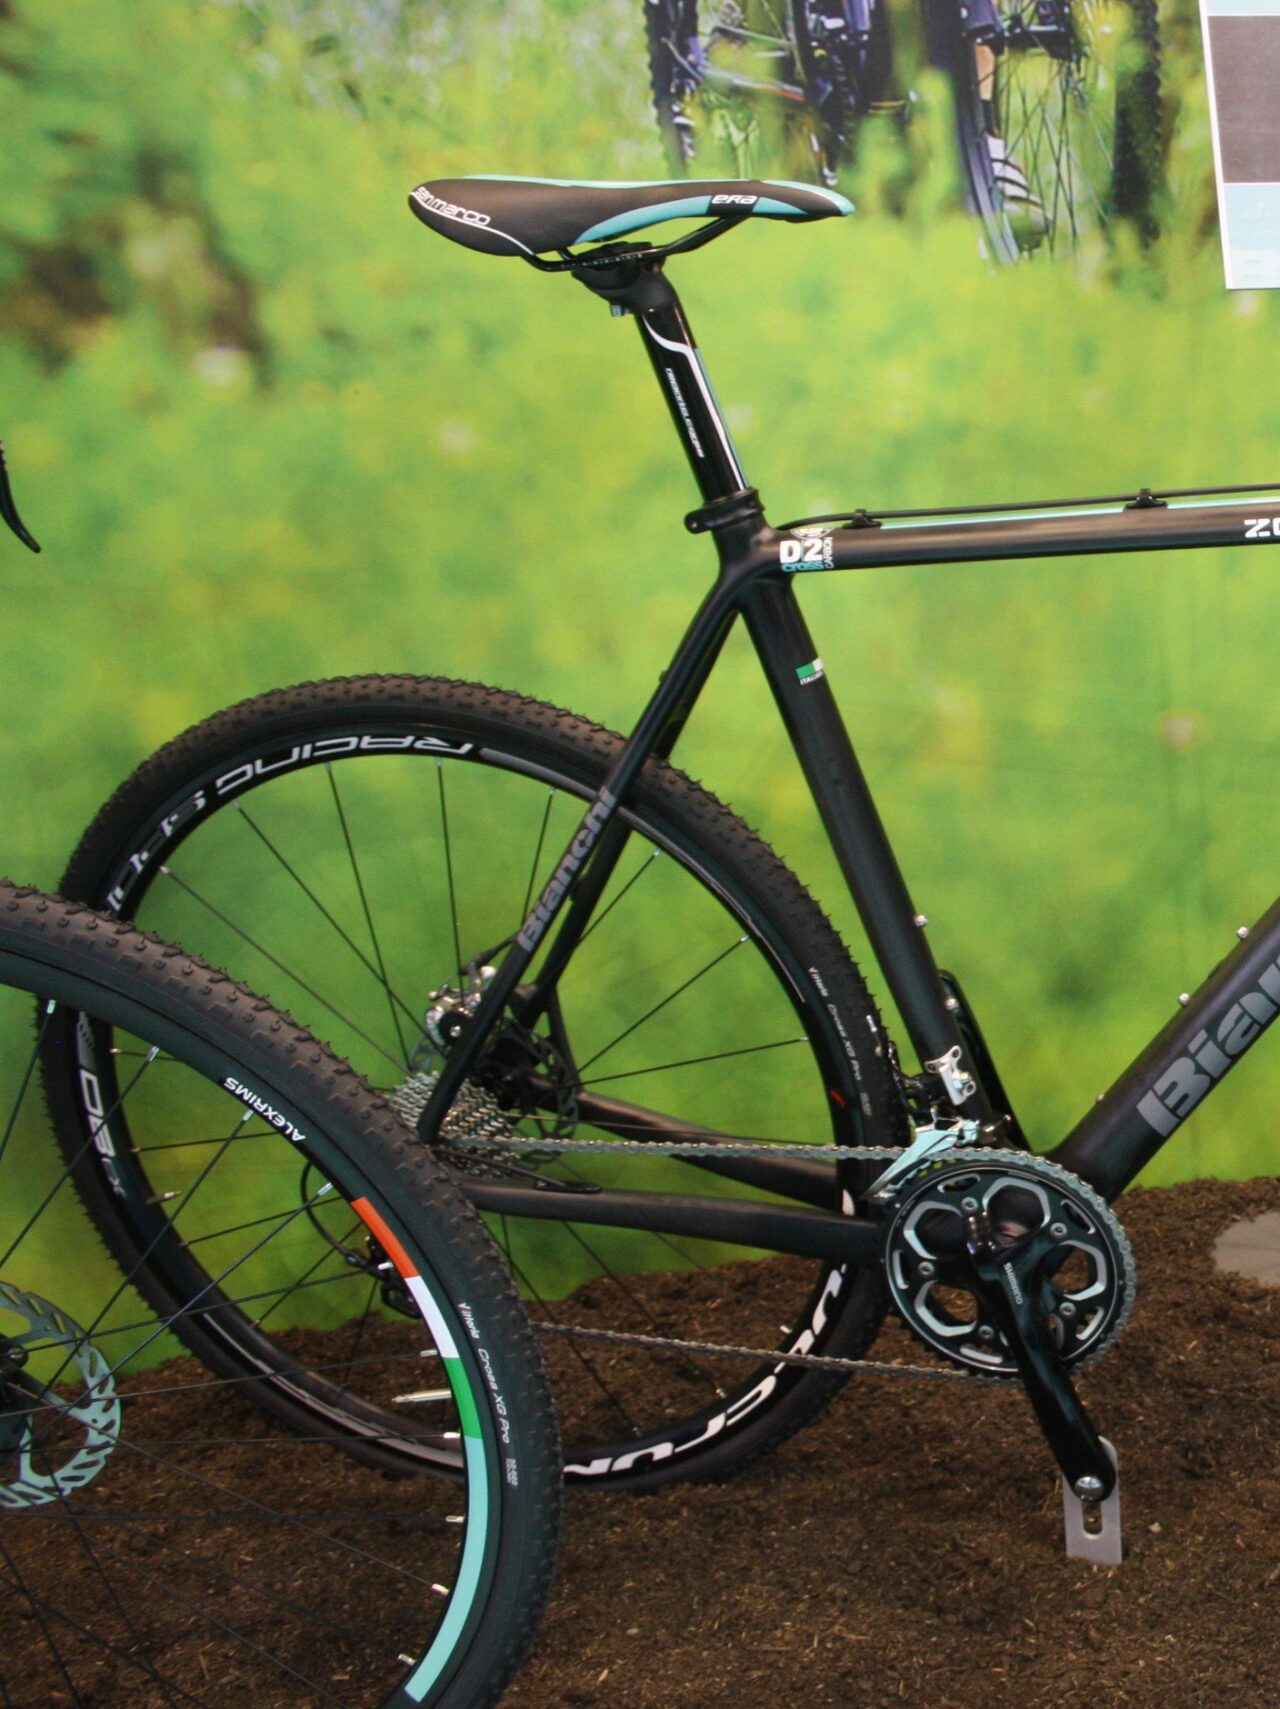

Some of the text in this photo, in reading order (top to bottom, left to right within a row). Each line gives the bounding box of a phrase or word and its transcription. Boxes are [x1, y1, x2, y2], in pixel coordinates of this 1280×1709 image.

[216, 734, 474, 798] RACING
[515, 788, 617, 951] Bianchi
[223, 1077, 306, 1142] ALEXRIMS
[1003, 1262, 1024, 1305] SHIMANO
[478, 1347, 498, 1391] Cross
[492, 1393, 508, 1416] XG
[500, 1419, 511, 1444] Pro
